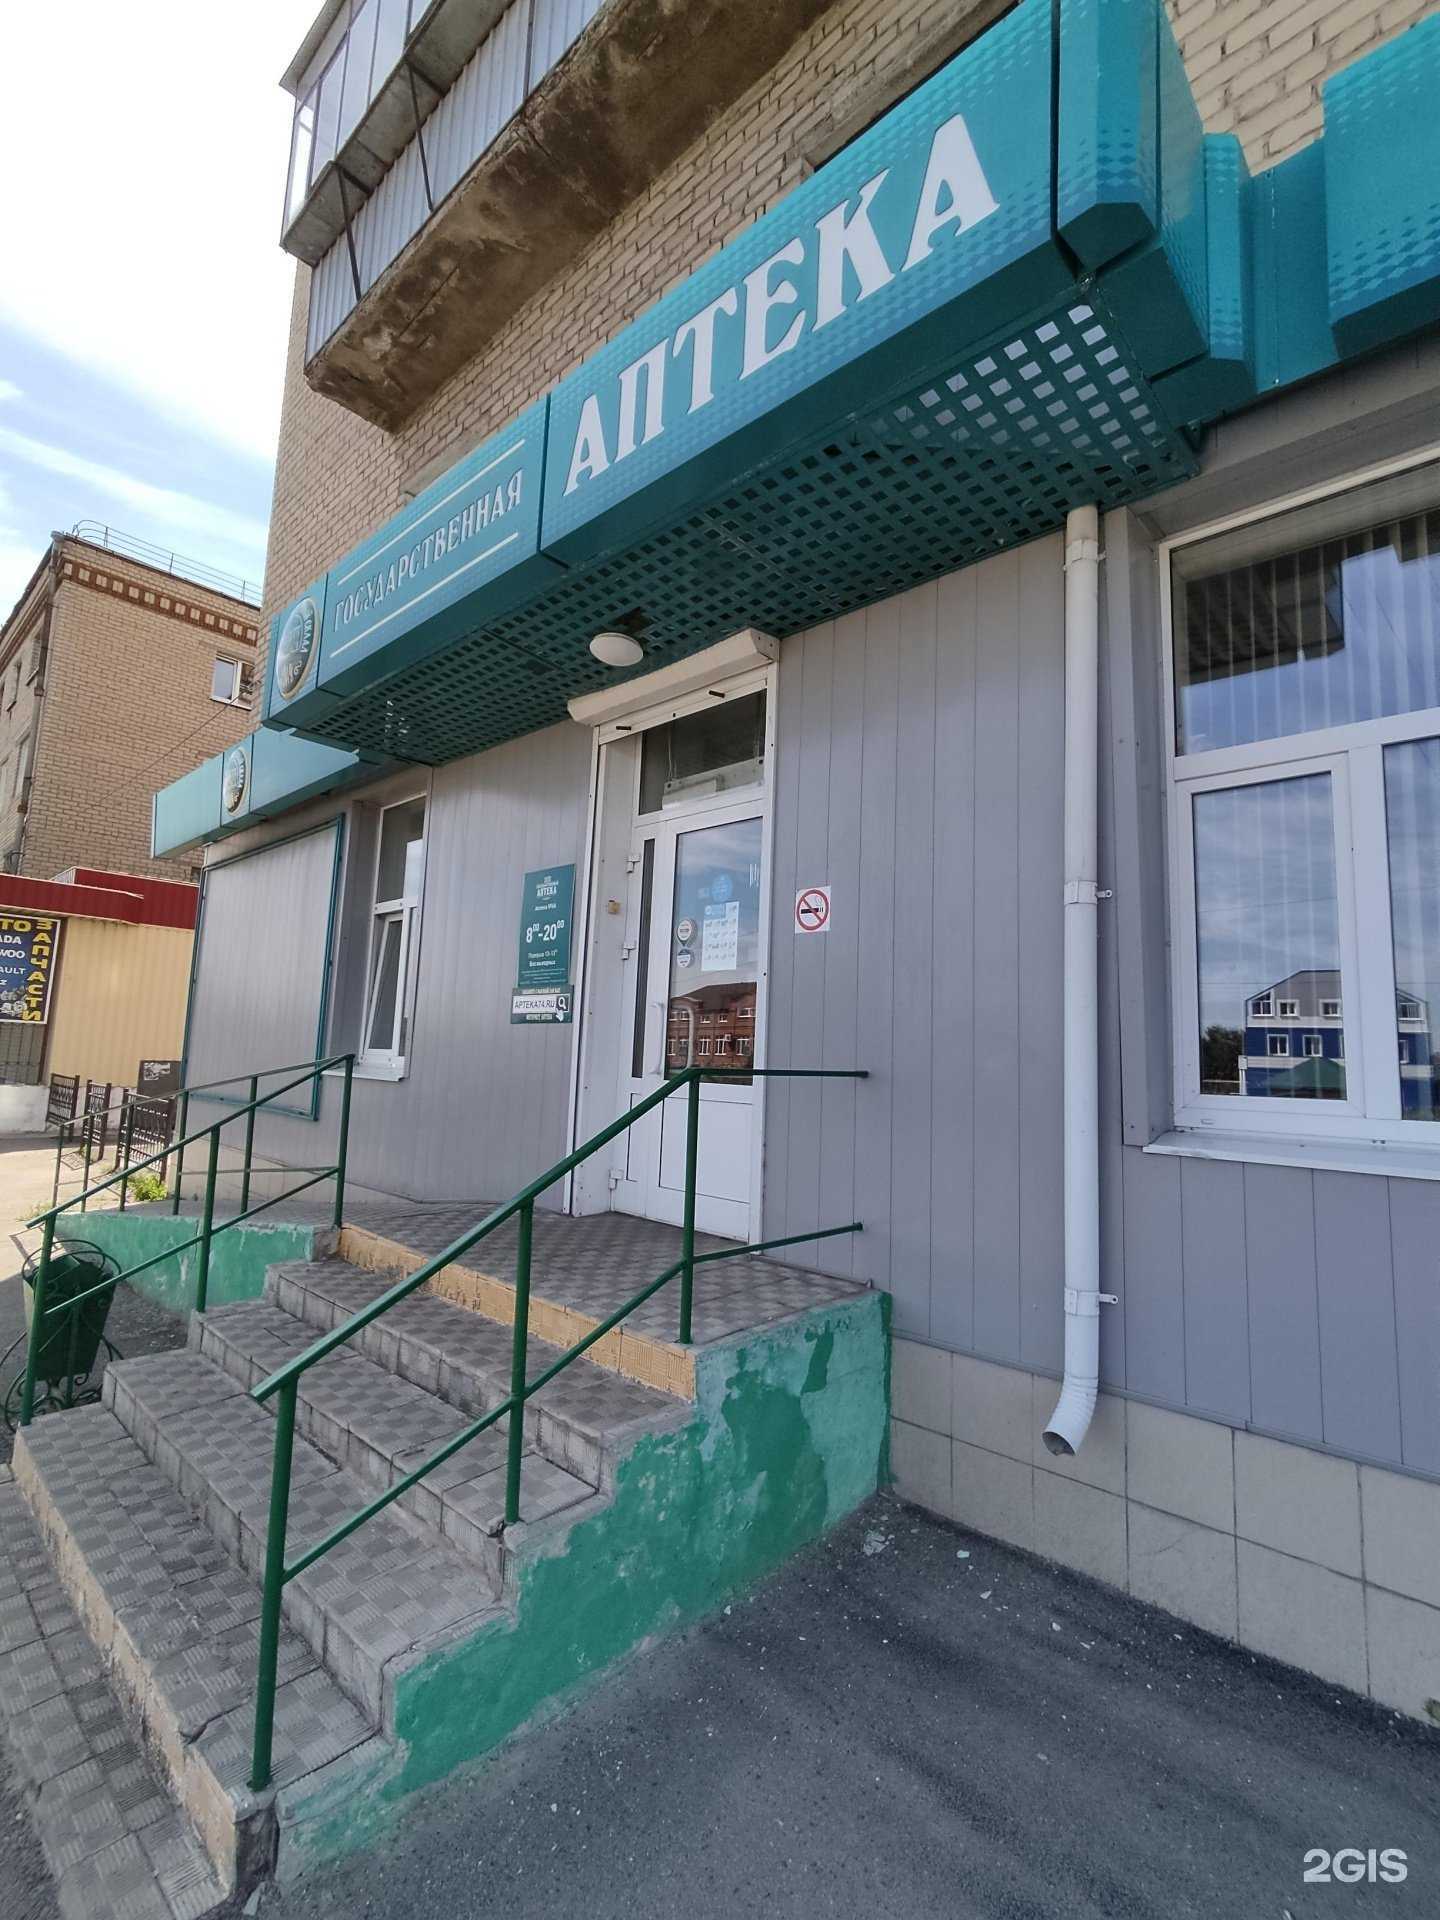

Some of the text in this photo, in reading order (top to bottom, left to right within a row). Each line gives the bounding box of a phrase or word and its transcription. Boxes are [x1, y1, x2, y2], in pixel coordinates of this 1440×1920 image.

[333, 113, 1000, 633] ГОСУДАРСТВЕННАЯ АПТЕКА
[22, 919, 53, 1020] ЗАПЧАСТИ
